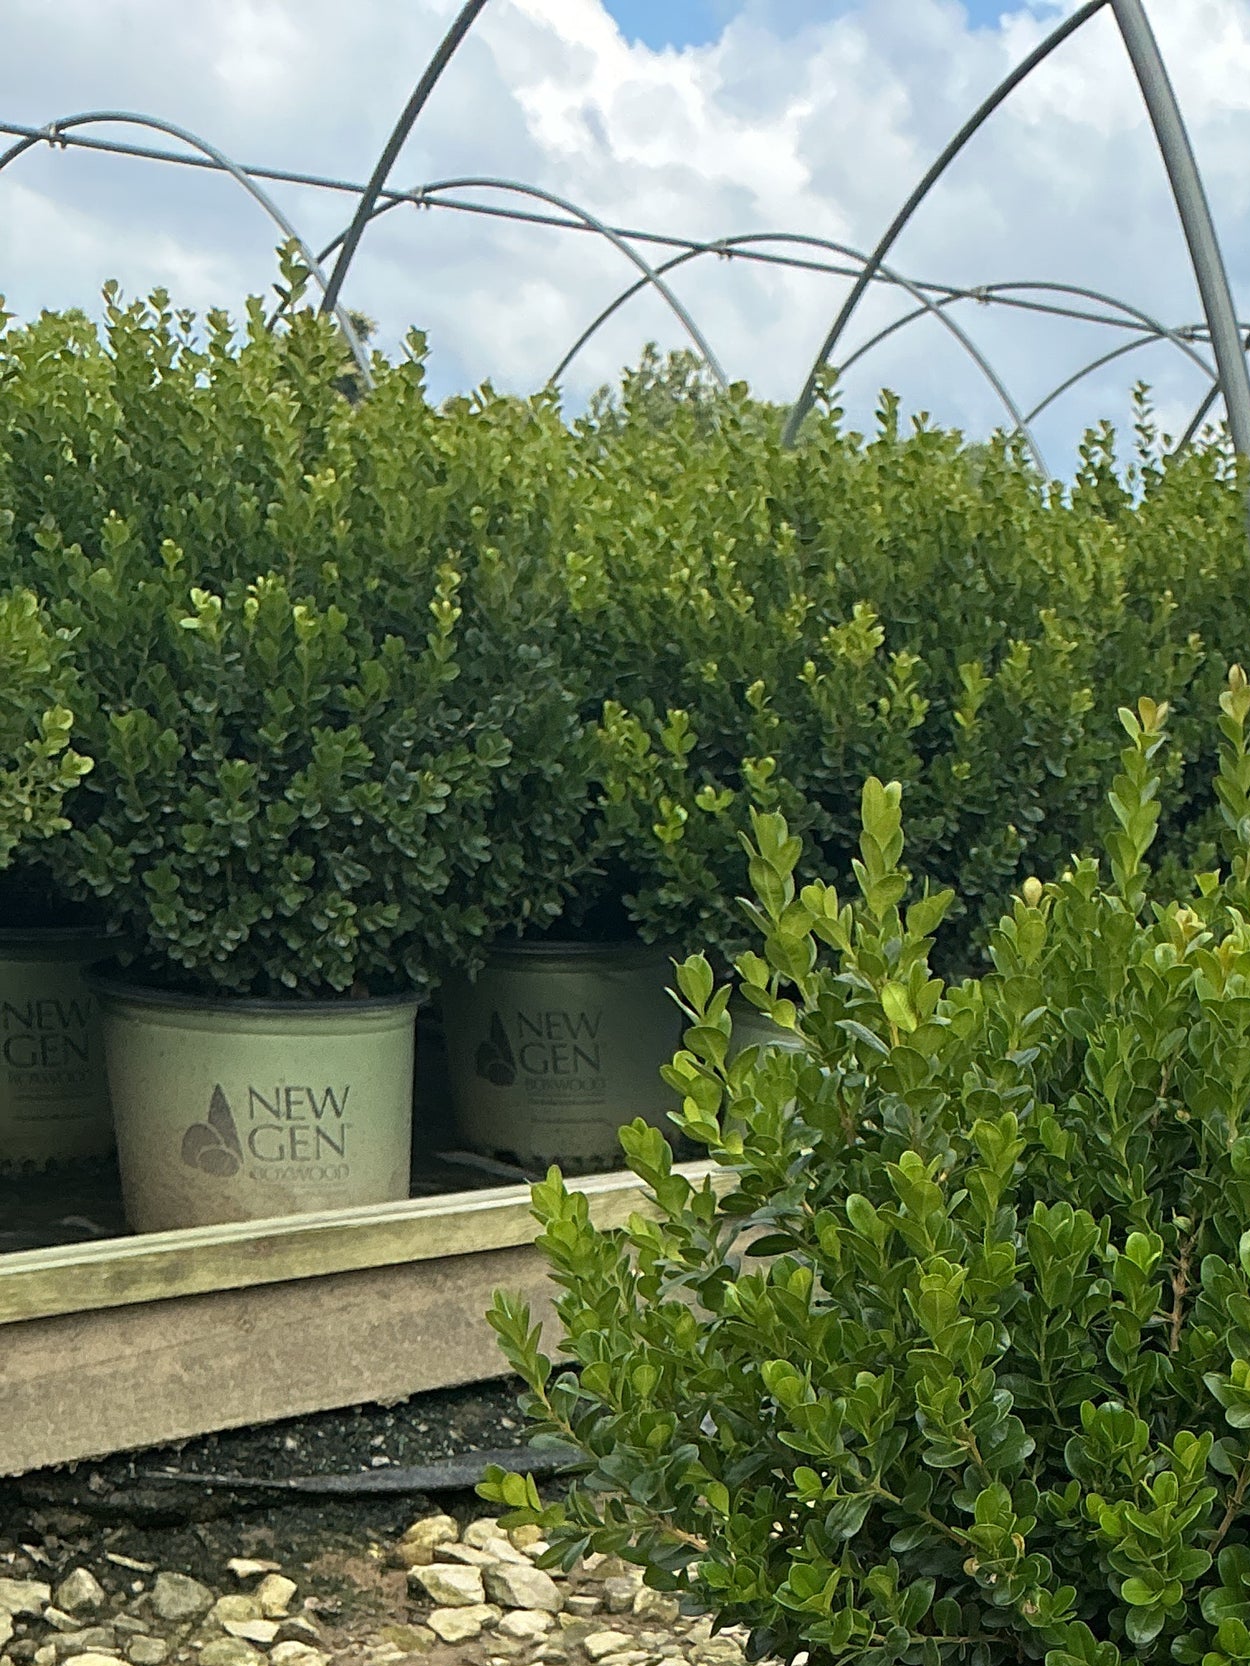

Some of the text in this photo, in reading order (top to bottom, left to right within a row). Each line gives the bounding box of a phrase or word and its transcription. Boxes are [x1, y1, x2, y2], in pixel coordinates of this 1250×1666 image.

[2, 998, 92, 1030] NEW
[517, 1011, 602, 1040] NEW
[4, 1033, 90, 1068] GEN
[519, 1041, 601, 1074] GEN
[248, 1085, 350, 1121] NEW
[248, 1123, 346, 1162] GEN
